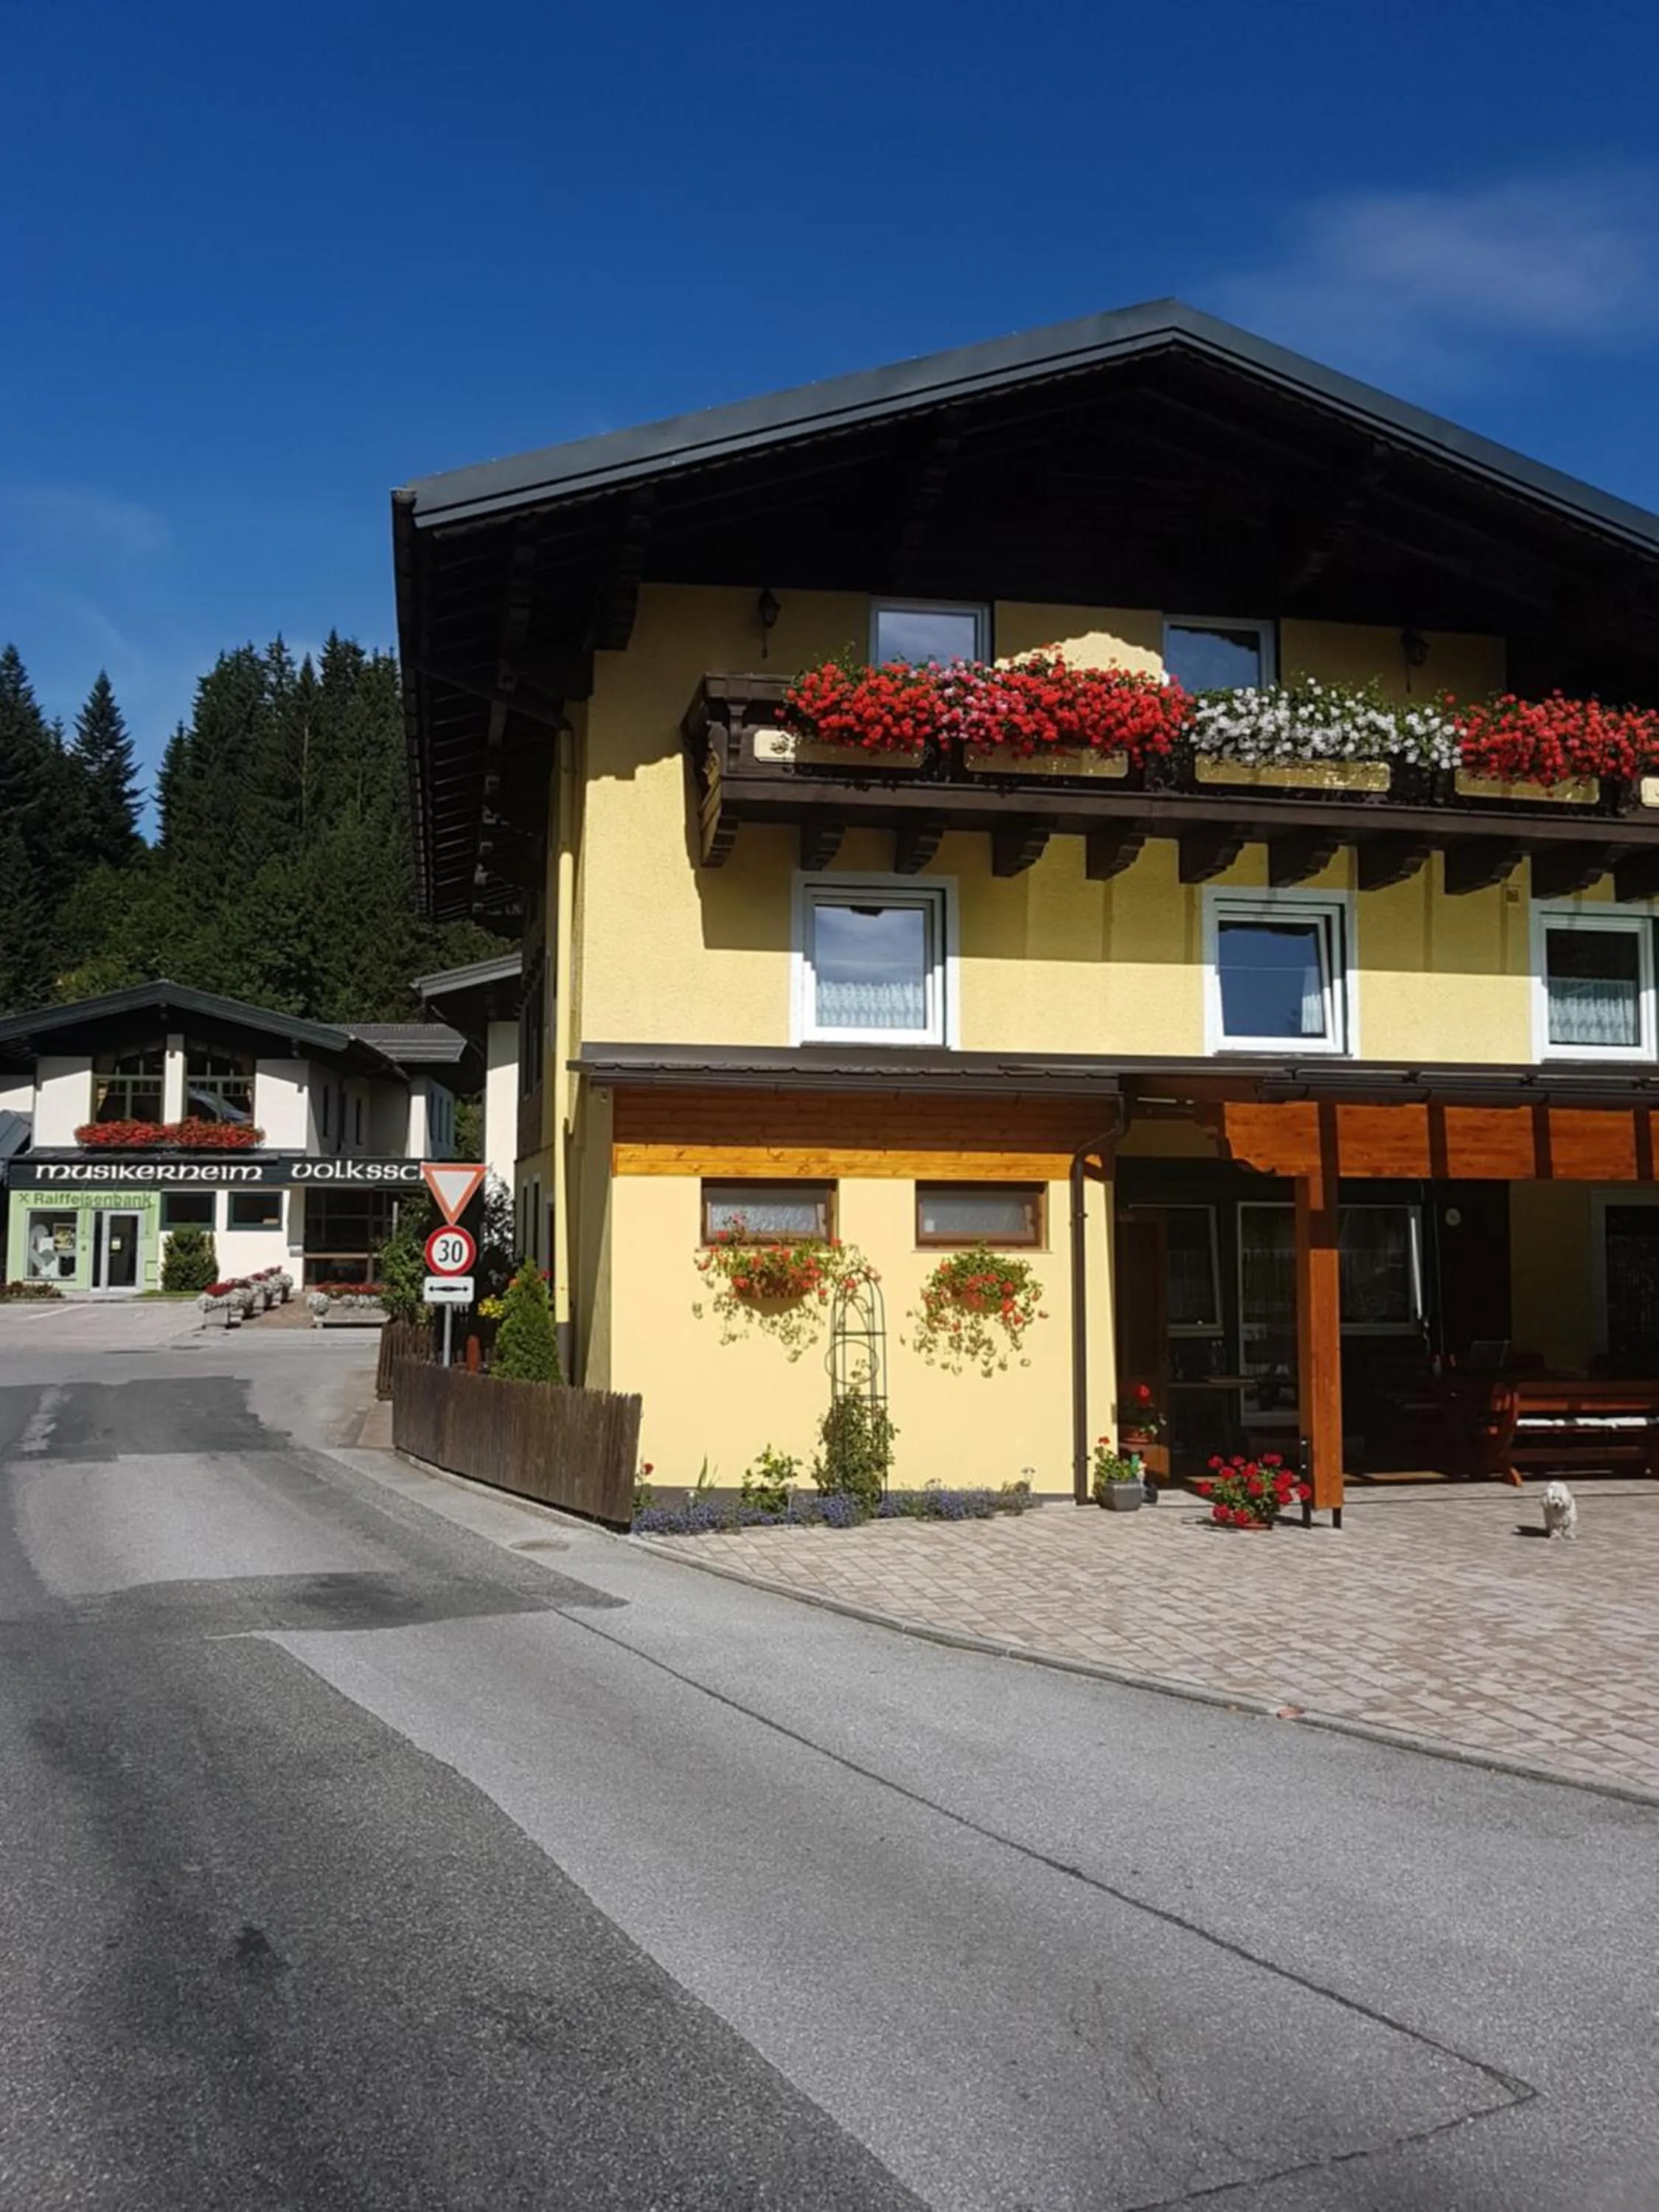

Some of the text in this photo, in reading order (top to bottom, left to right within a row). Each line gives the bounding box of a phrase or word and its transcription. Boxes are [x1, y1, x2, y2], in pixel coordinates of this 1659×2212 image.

[291, 1161, 424, 1180] volkssc
[33, 1192, 152, 1206] Raiffeisenbank
[438, 1239, 463, 1263] 30
